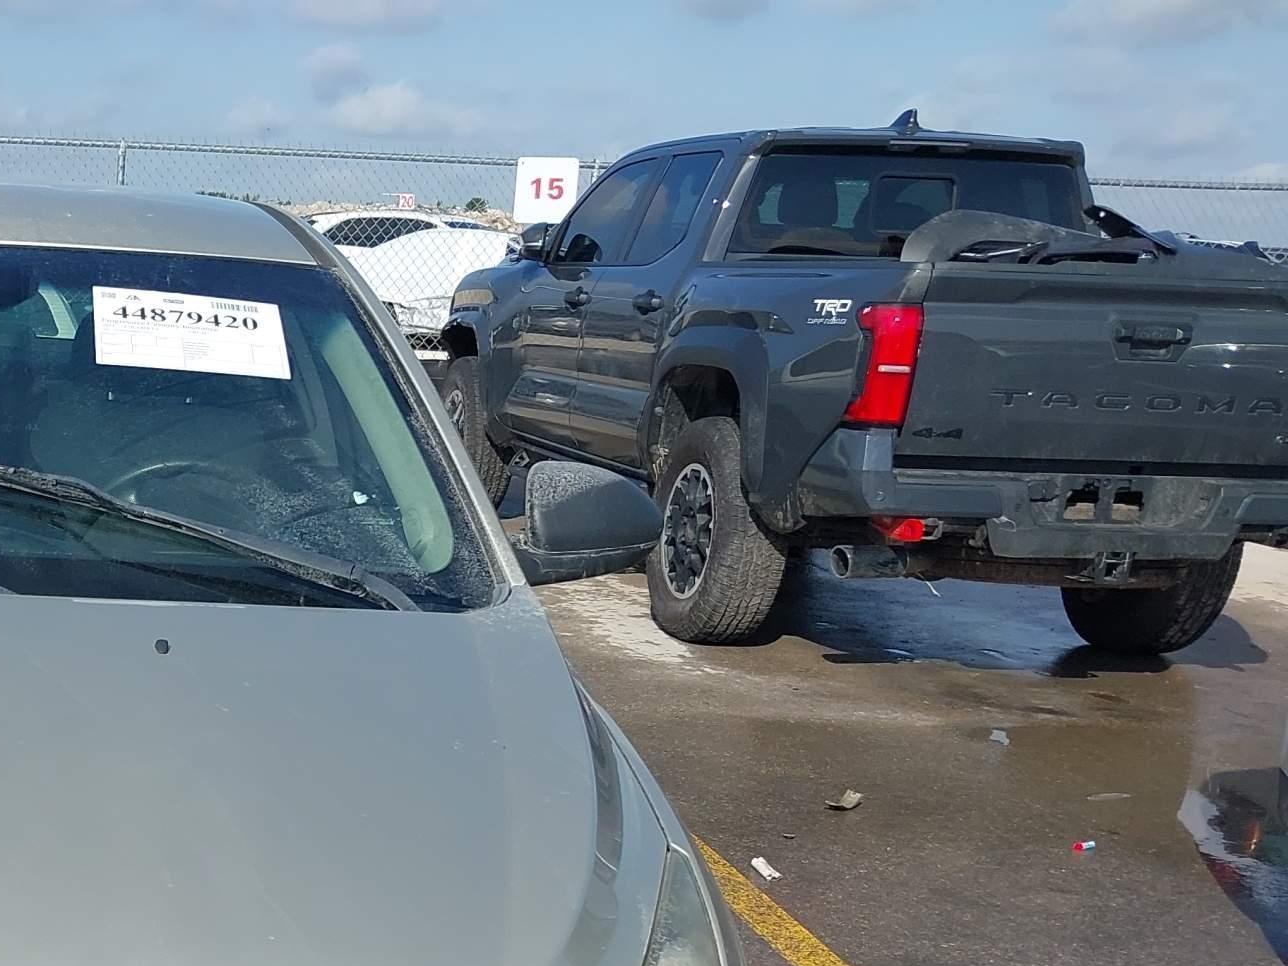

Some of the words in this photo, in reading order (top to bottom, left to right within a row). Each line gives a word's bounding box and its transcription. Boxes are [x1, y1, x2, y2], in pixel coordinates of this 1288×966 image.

[530, 177, 564, 200] 15
[400, 195, 414, 209] 20
[112, 304, 259, 331] 44879420
[813, 299, 852, 316] TRD
[988, 388, 1284, 417] TACOMA
